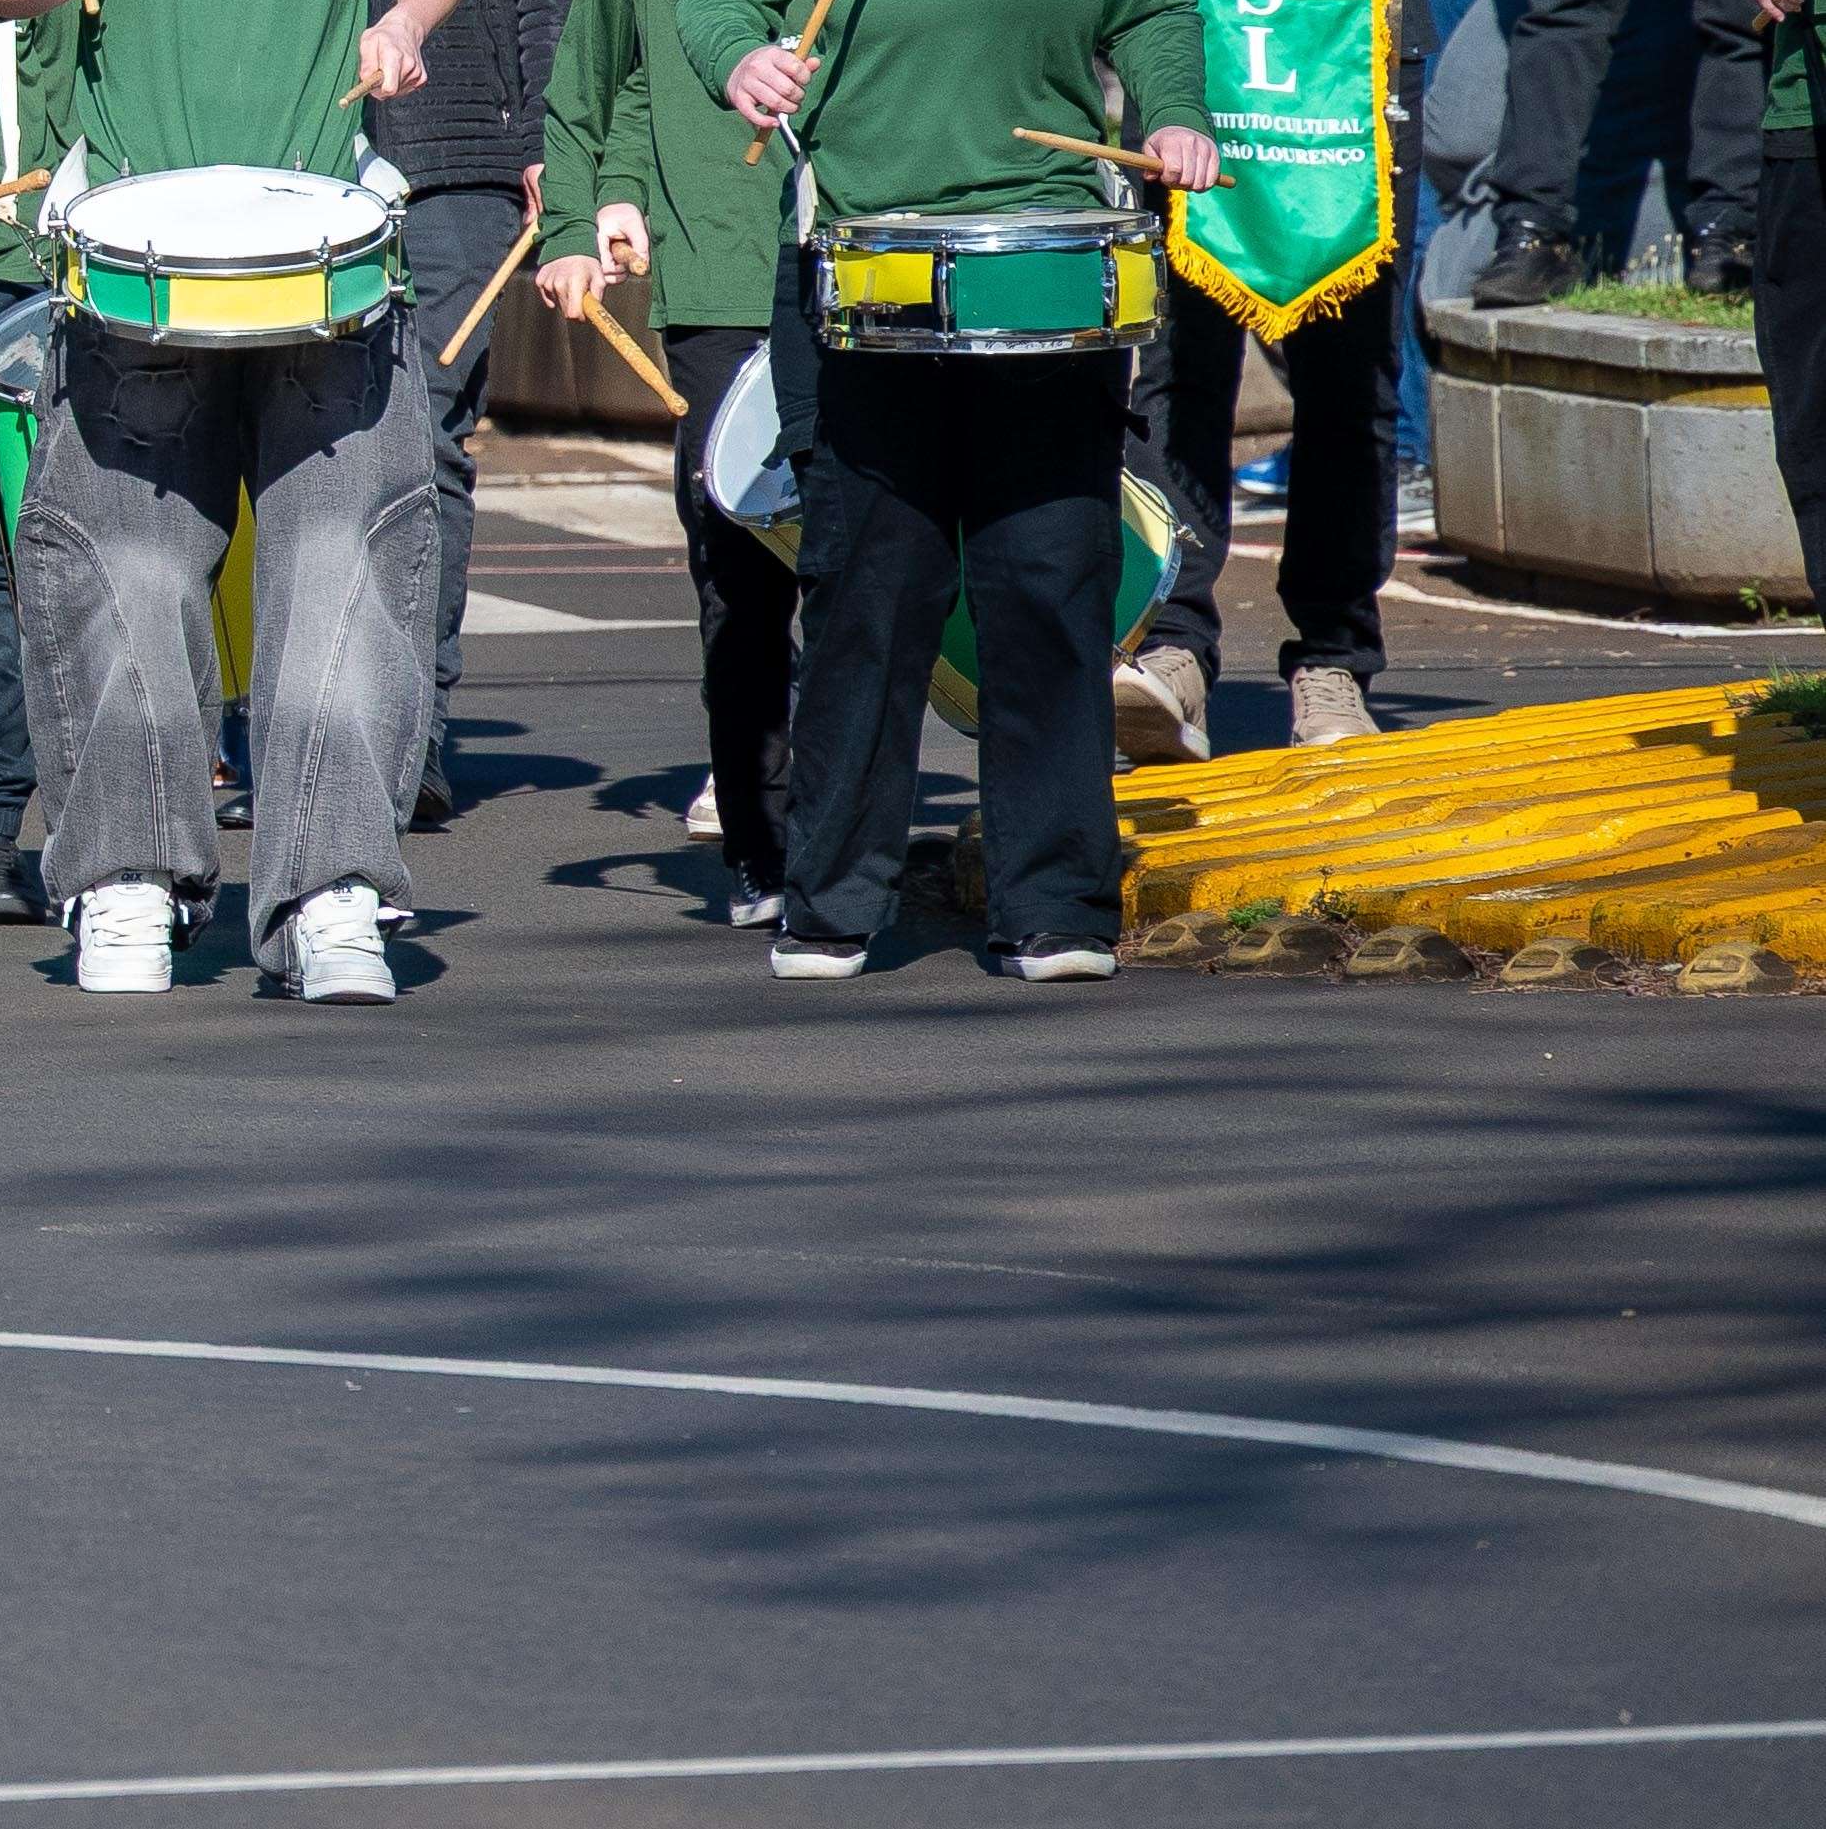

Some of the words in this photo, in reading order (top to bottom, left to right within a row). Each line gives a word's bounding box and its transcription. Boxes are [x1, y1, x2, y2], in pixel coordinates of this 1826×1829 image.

[1210, 112, 1273, 131] TITUTO
[1273, 115, 1365, 135] CULTURAL
[1222, 140, 1254, 161] SÃO
[1256, 143, 1366, 167] LOURENÇO
